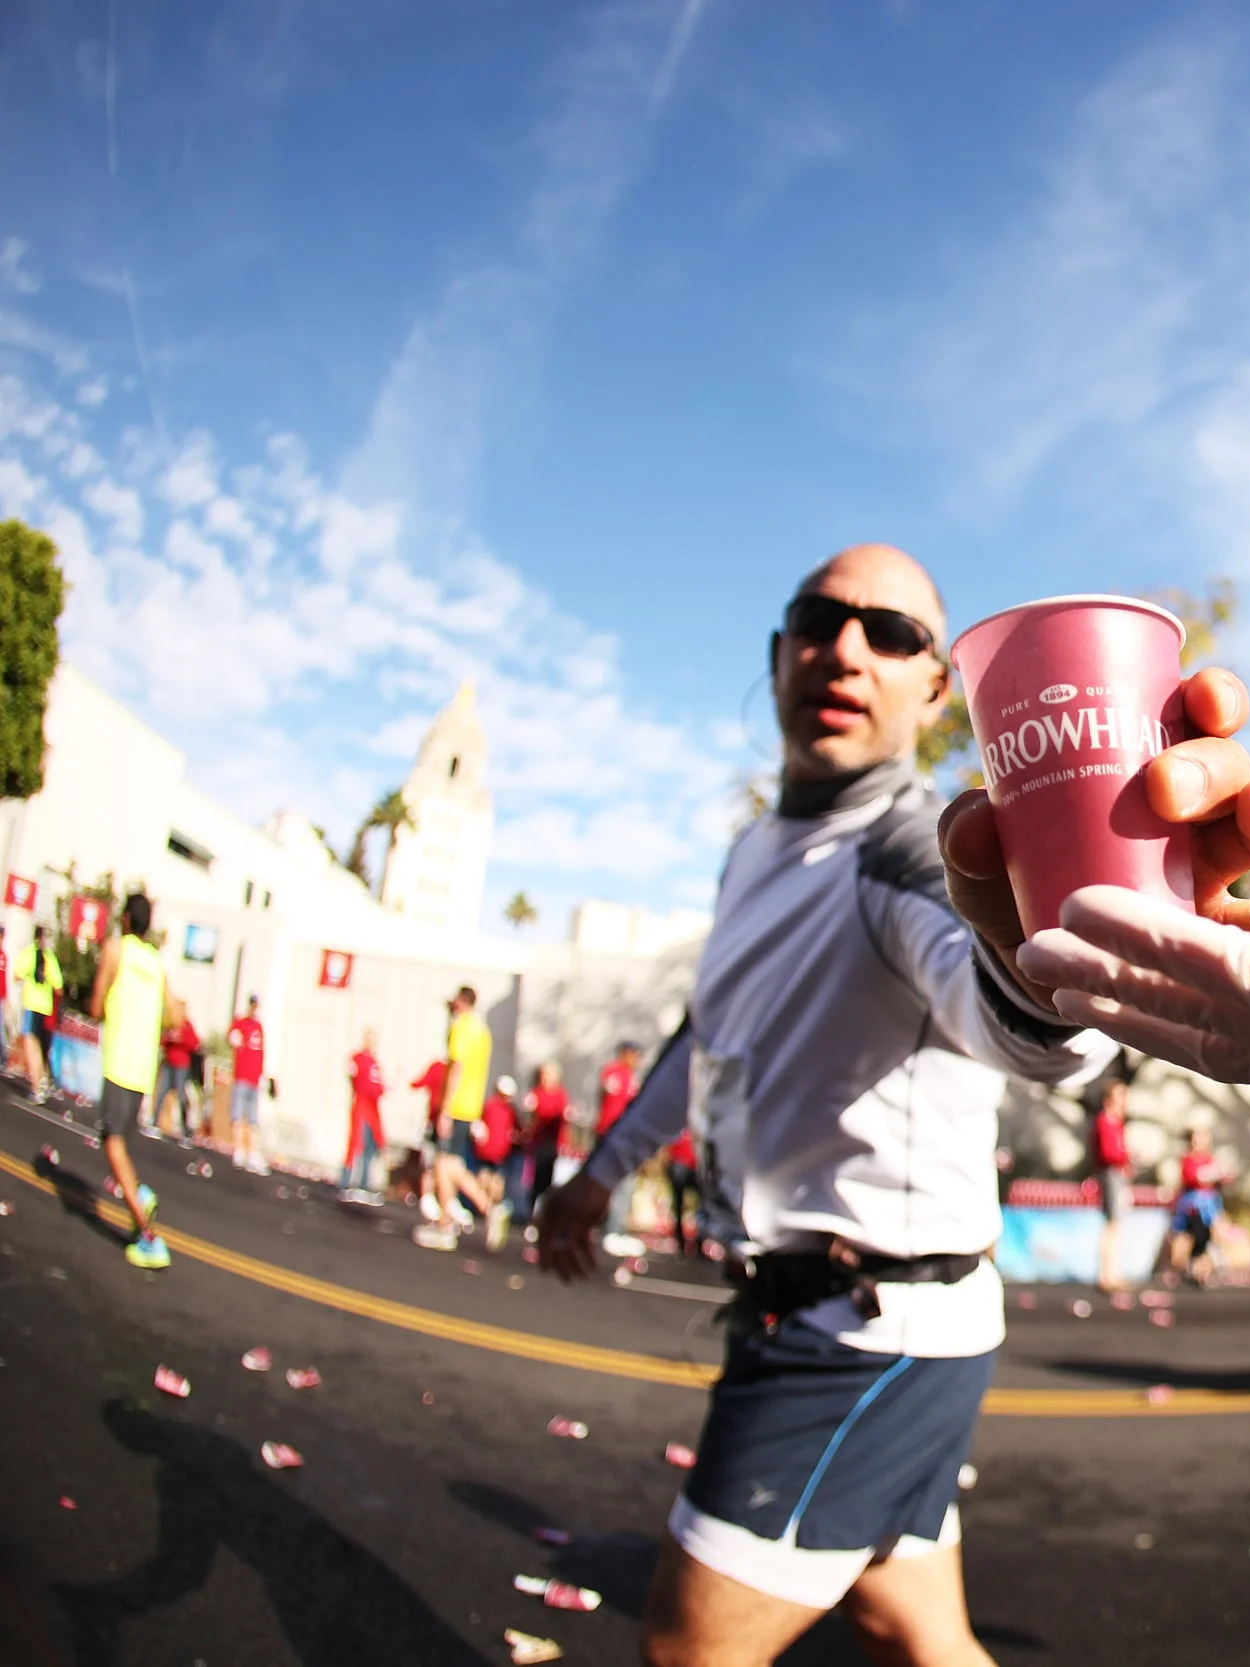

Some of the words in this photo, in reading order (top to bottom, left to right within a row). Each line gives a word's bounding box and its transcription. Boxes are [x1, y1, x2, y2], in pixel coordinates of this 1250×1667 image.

[1044, 689, 1070, 701] 1894
[1001, 699, 1030, 718] PURE
[1021, 768, 1075, 795] MOUNTAIN
[1079, 763, 1121, 778] SPRING
